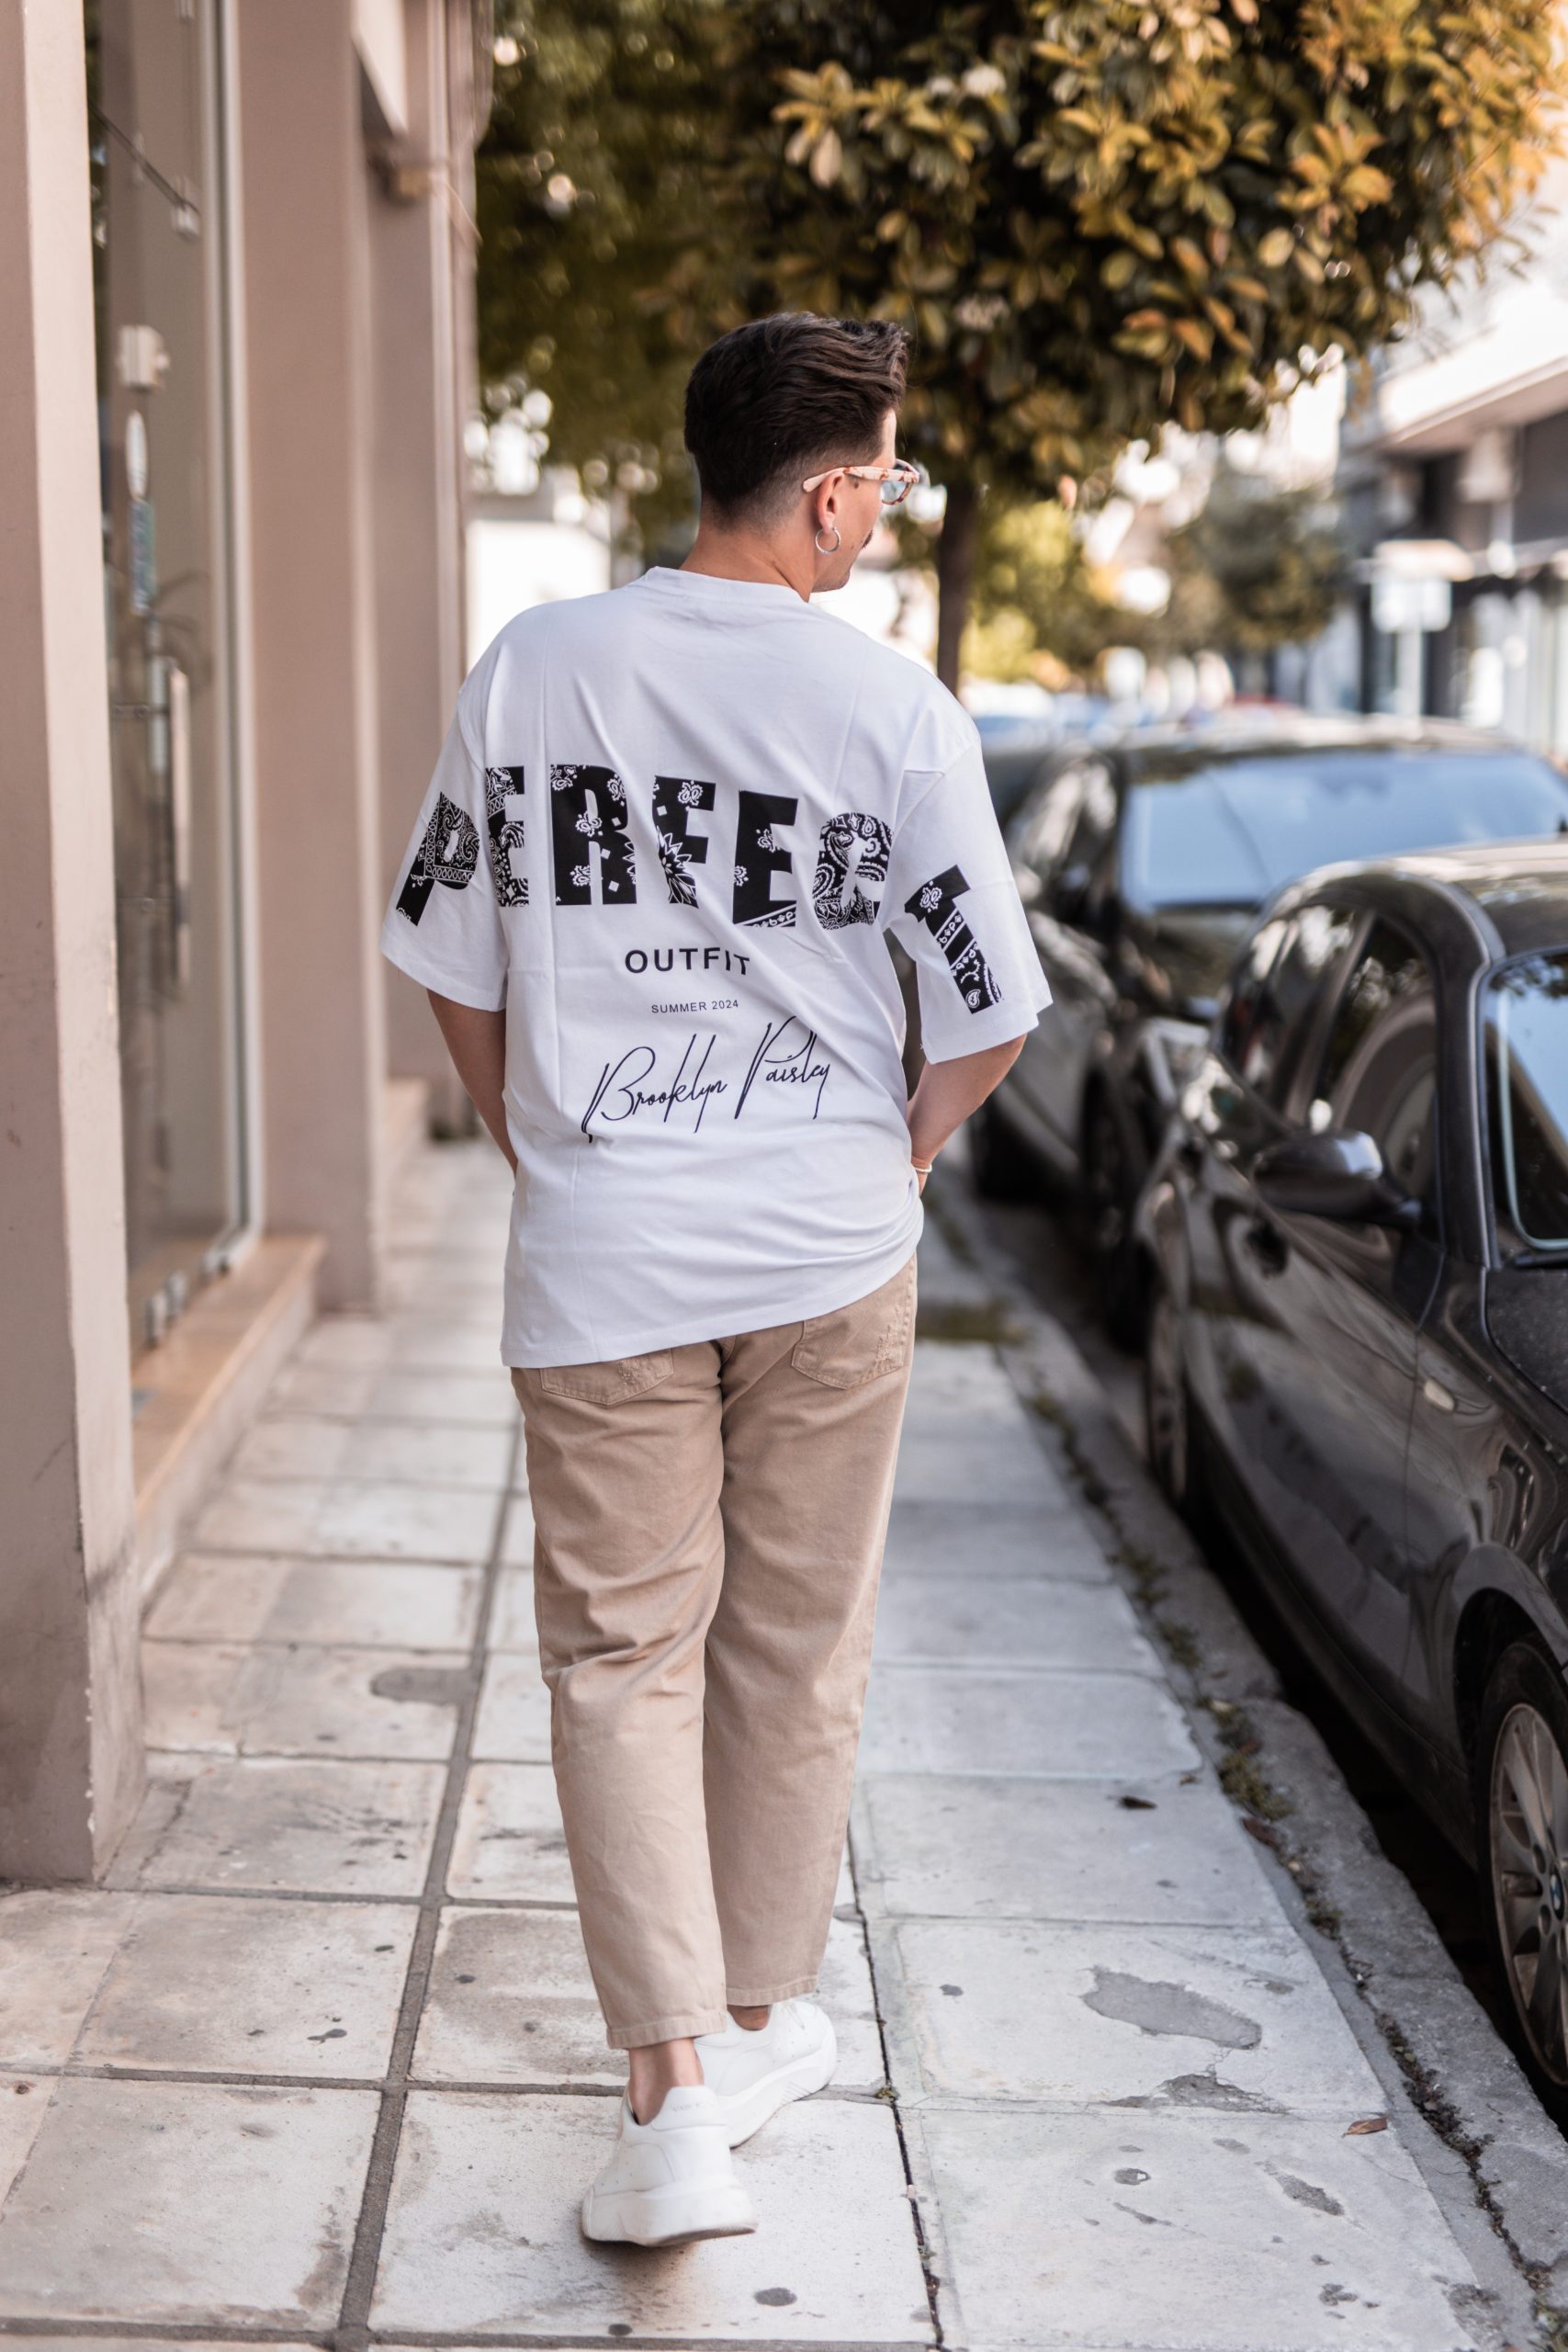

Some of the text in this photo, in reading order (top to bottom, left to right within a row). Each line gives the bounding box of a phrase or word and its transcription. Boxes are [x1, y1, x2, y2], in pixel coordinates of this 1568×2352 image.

[395, 763, 1004, 1014] PERFECT
[625, 946, 750, 976] OUTFIT
[651, 999, 739, 1013] SUMMER 2024
[581, 1015, 830, 1144] Brooklyn Paisley
